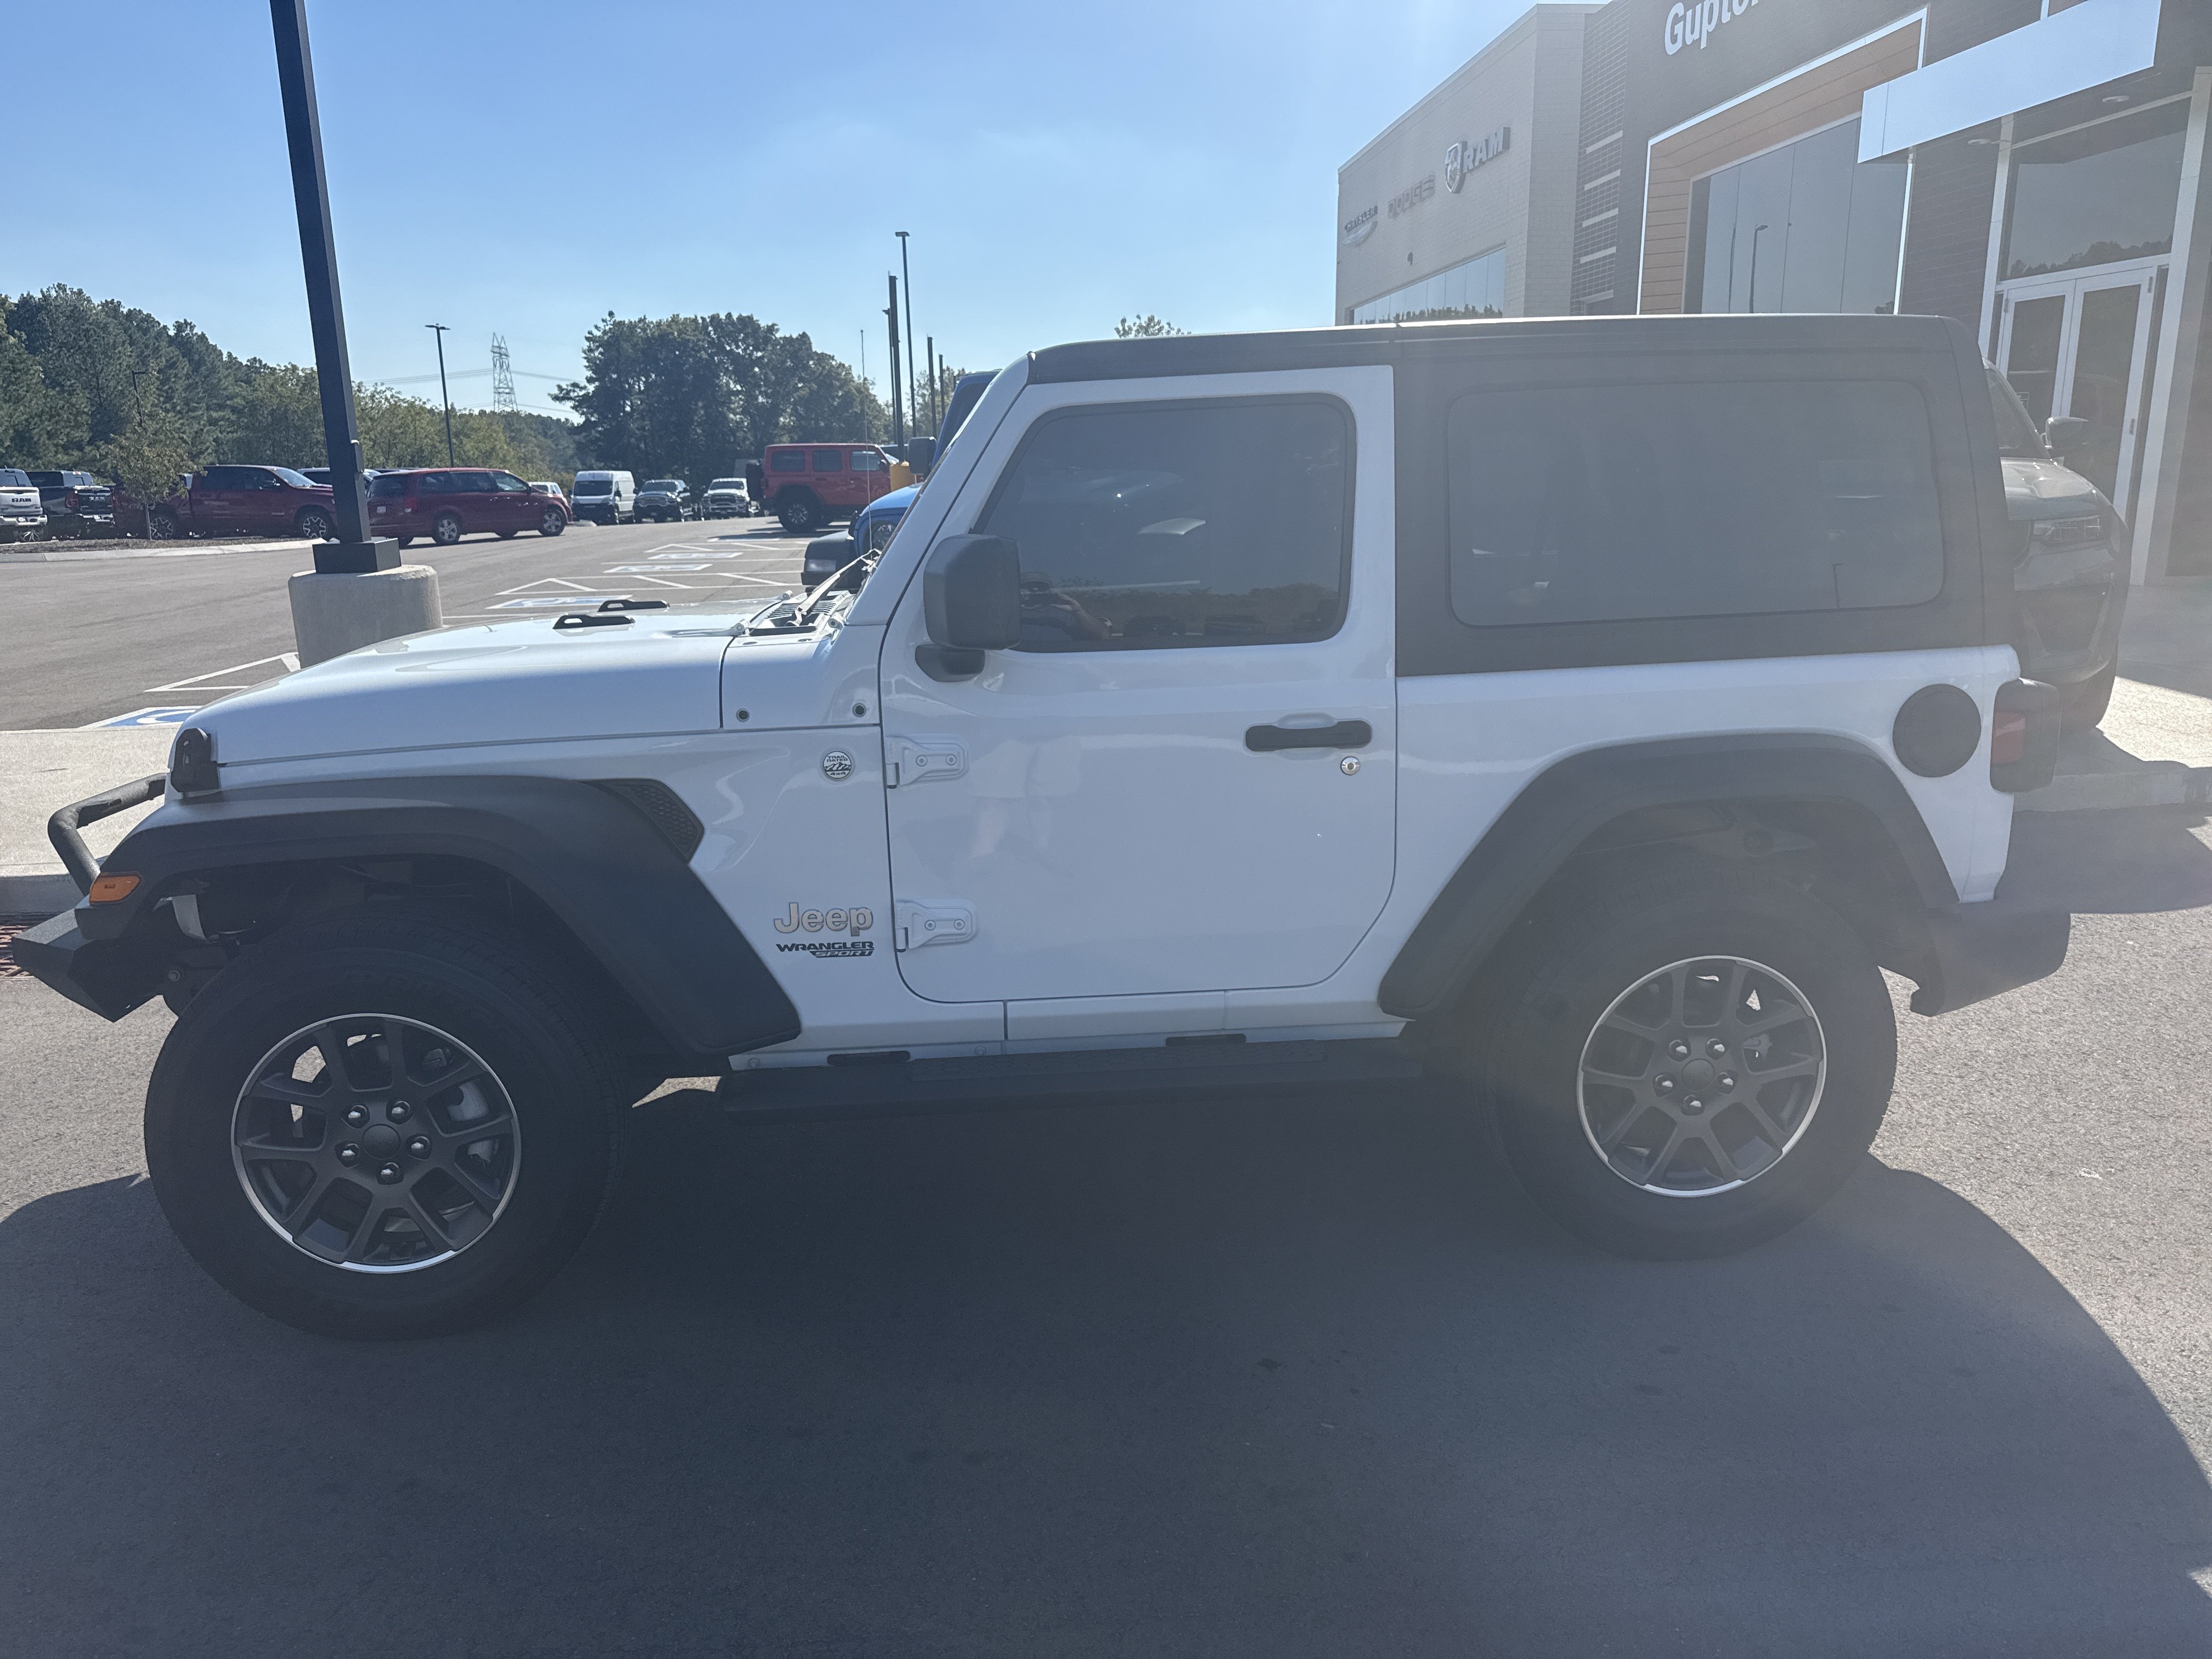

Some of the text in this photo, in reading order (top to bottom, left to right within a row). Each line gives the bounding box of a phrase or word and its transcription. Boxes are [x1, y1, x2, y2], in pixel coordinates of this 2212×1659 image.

[1463, 127, 1508, 173] RAM
[1387, 174, 1436, 219] DODGE
[1344, 205, 1378, 233] CHRYSLER
[774, 902, 873, 936] Jeep
[776, 941, 874, 952] WRANGLER
